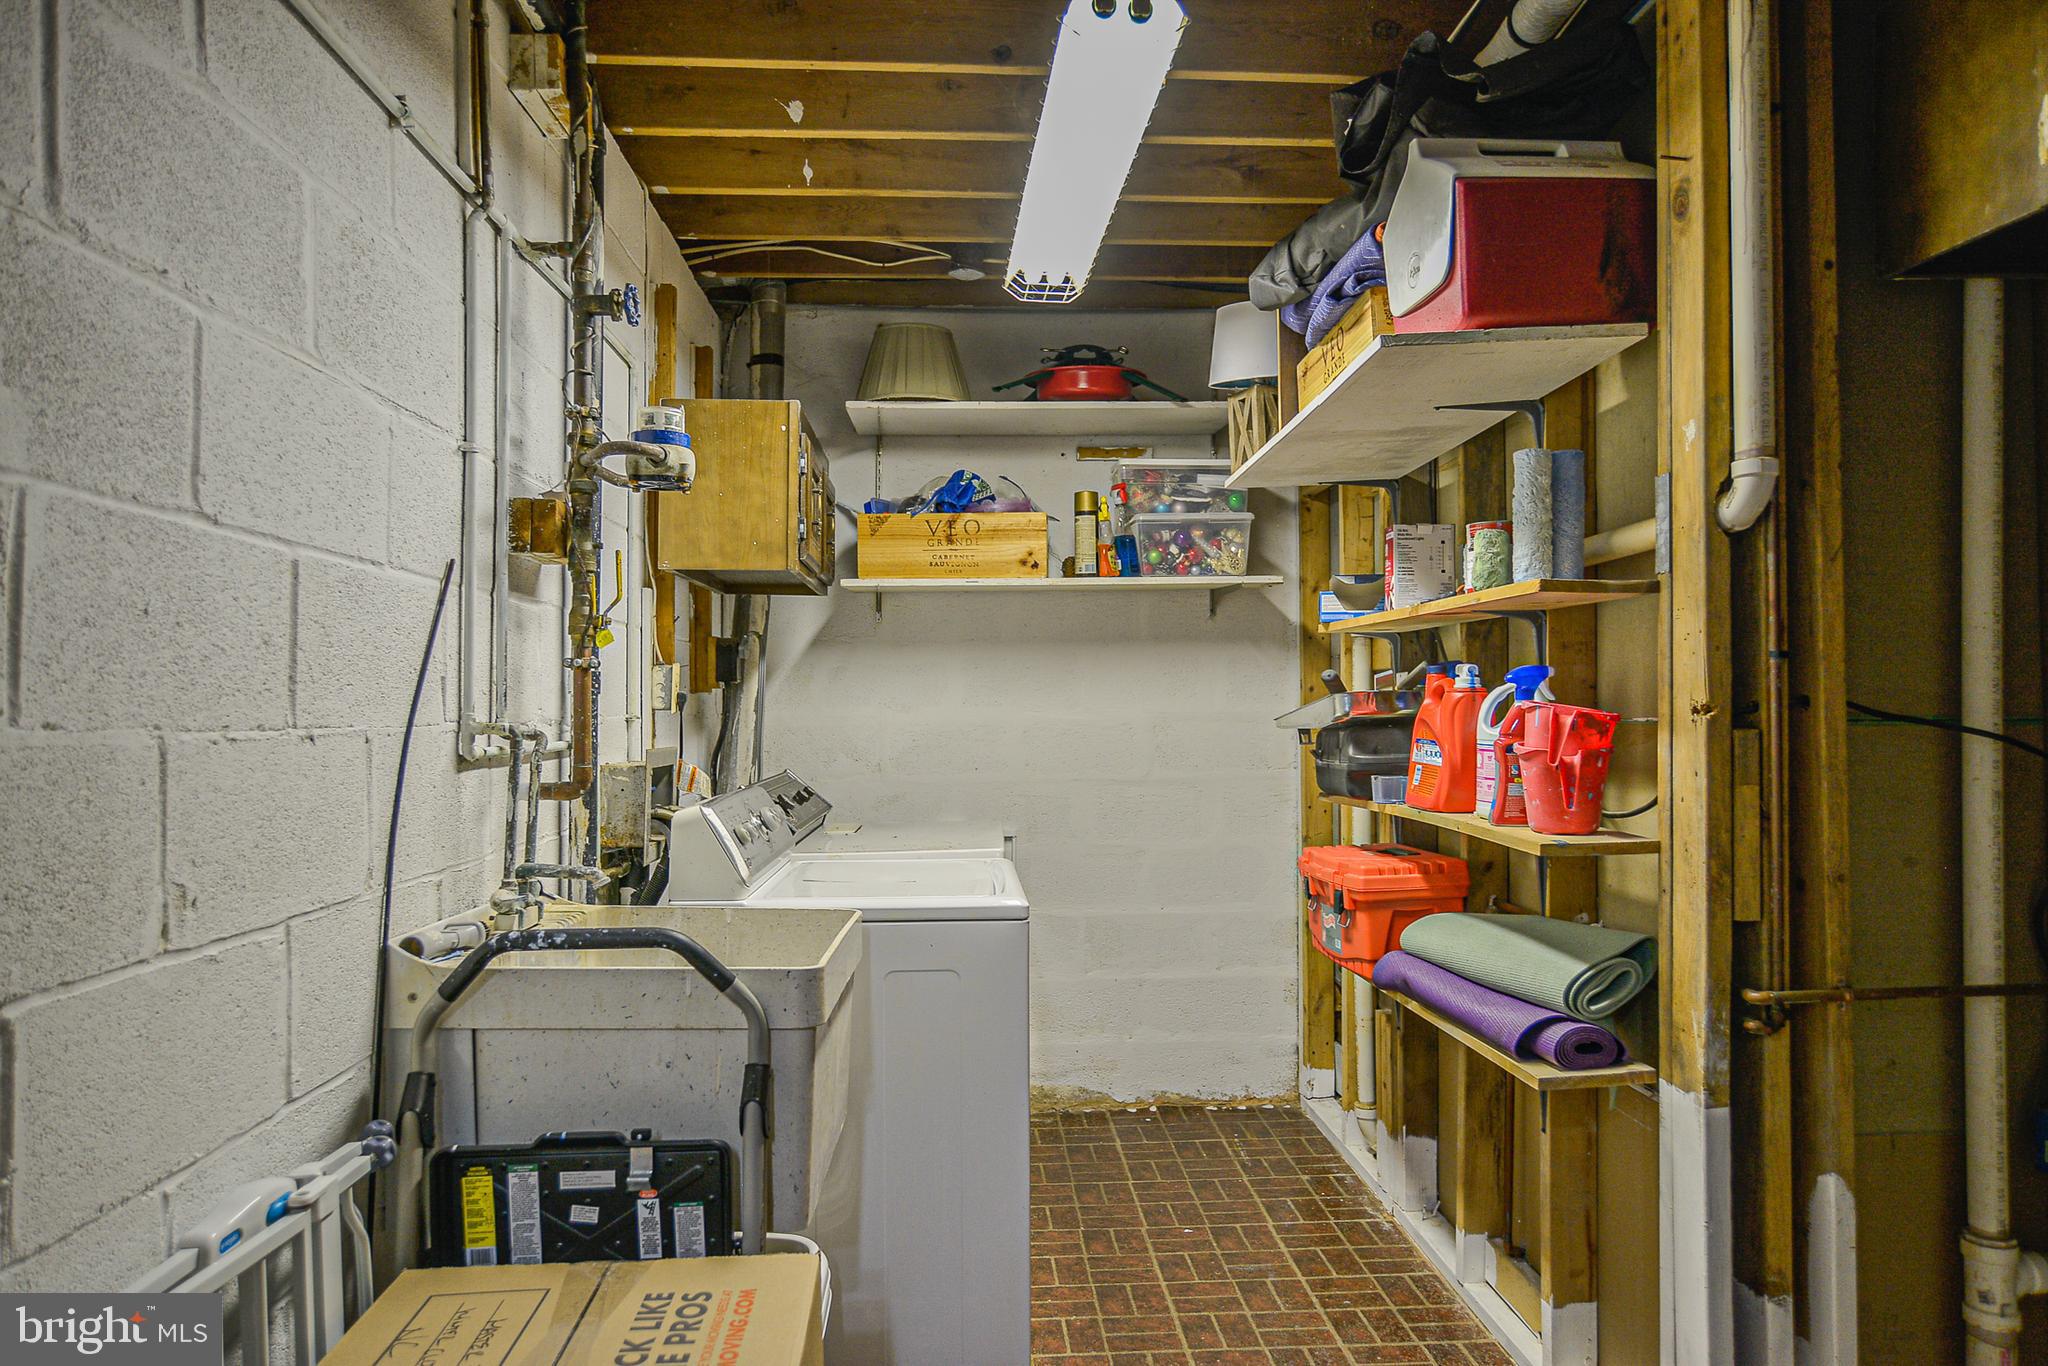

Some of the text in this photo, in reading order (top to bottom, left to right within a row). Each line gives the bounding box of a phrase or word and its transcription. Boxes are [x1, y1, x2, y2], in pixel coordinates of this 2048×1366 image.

[1321, 326, 1345, 367] VEO
[924, 519, 981, 537] VEO
[926, 538, 981, 548] GRANDE
[629, 1291, 676, 1332] LIKE
[663, 1291, 713, 1346] PROS
